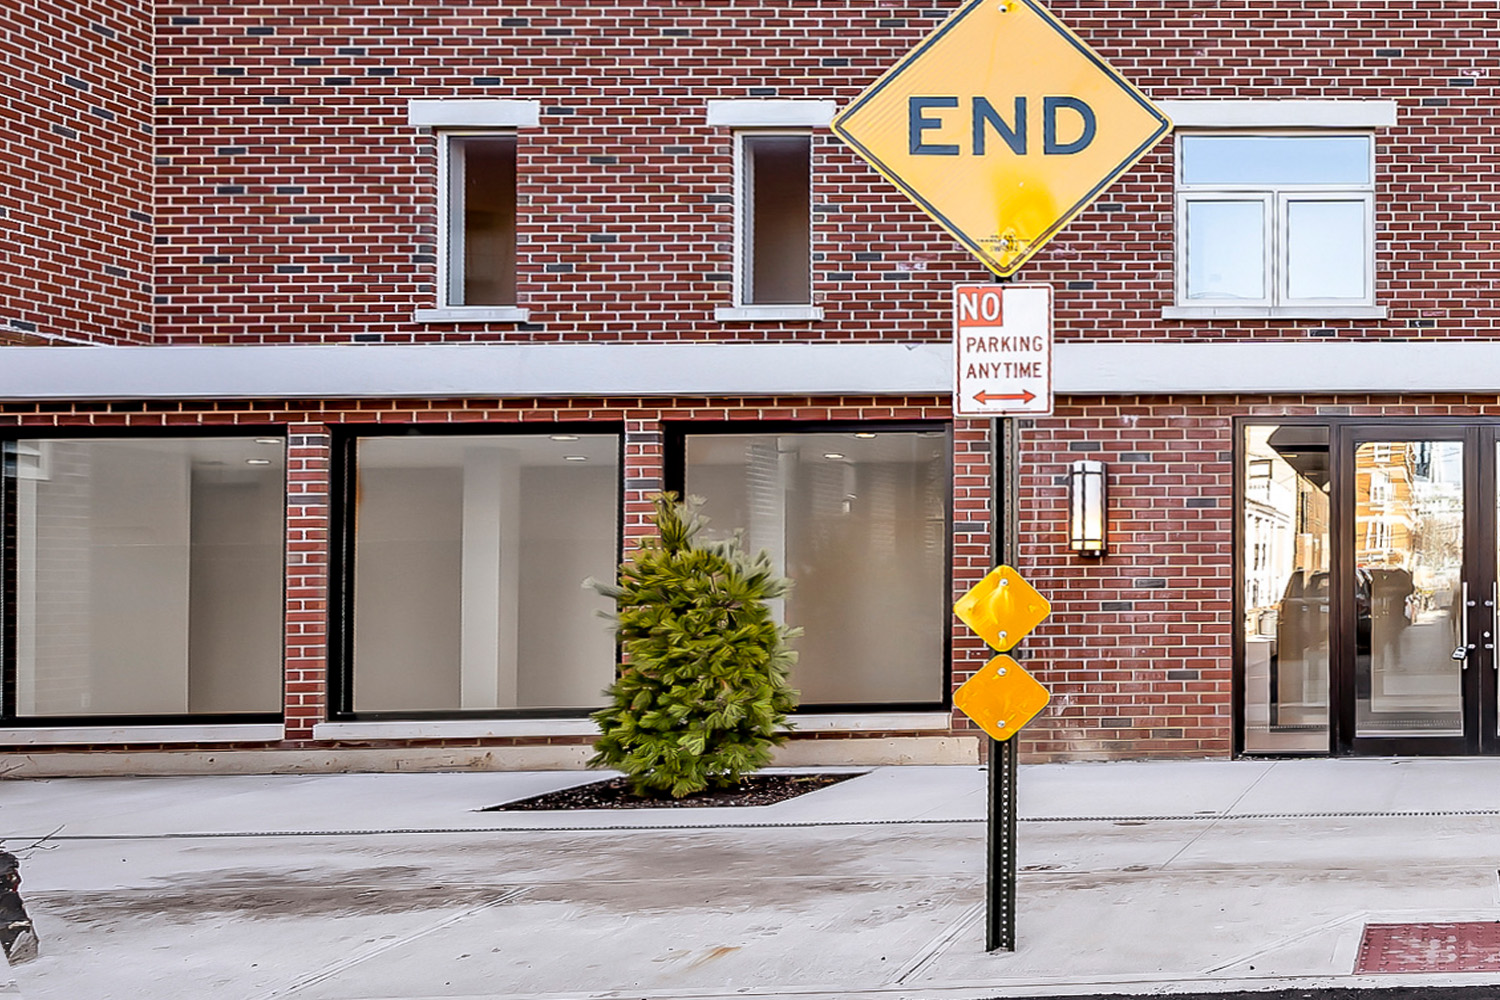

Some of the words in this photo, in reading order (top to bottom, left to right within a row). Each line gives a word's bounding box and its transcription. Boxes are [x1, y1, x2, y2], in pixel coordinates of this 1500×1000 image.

[908, 96, 1097, 156] END
[959, 291, 1001, 322] NO
[966, 335, 1043, 353] PARKING
[966, 361, 1042, 379] ANYTIME
